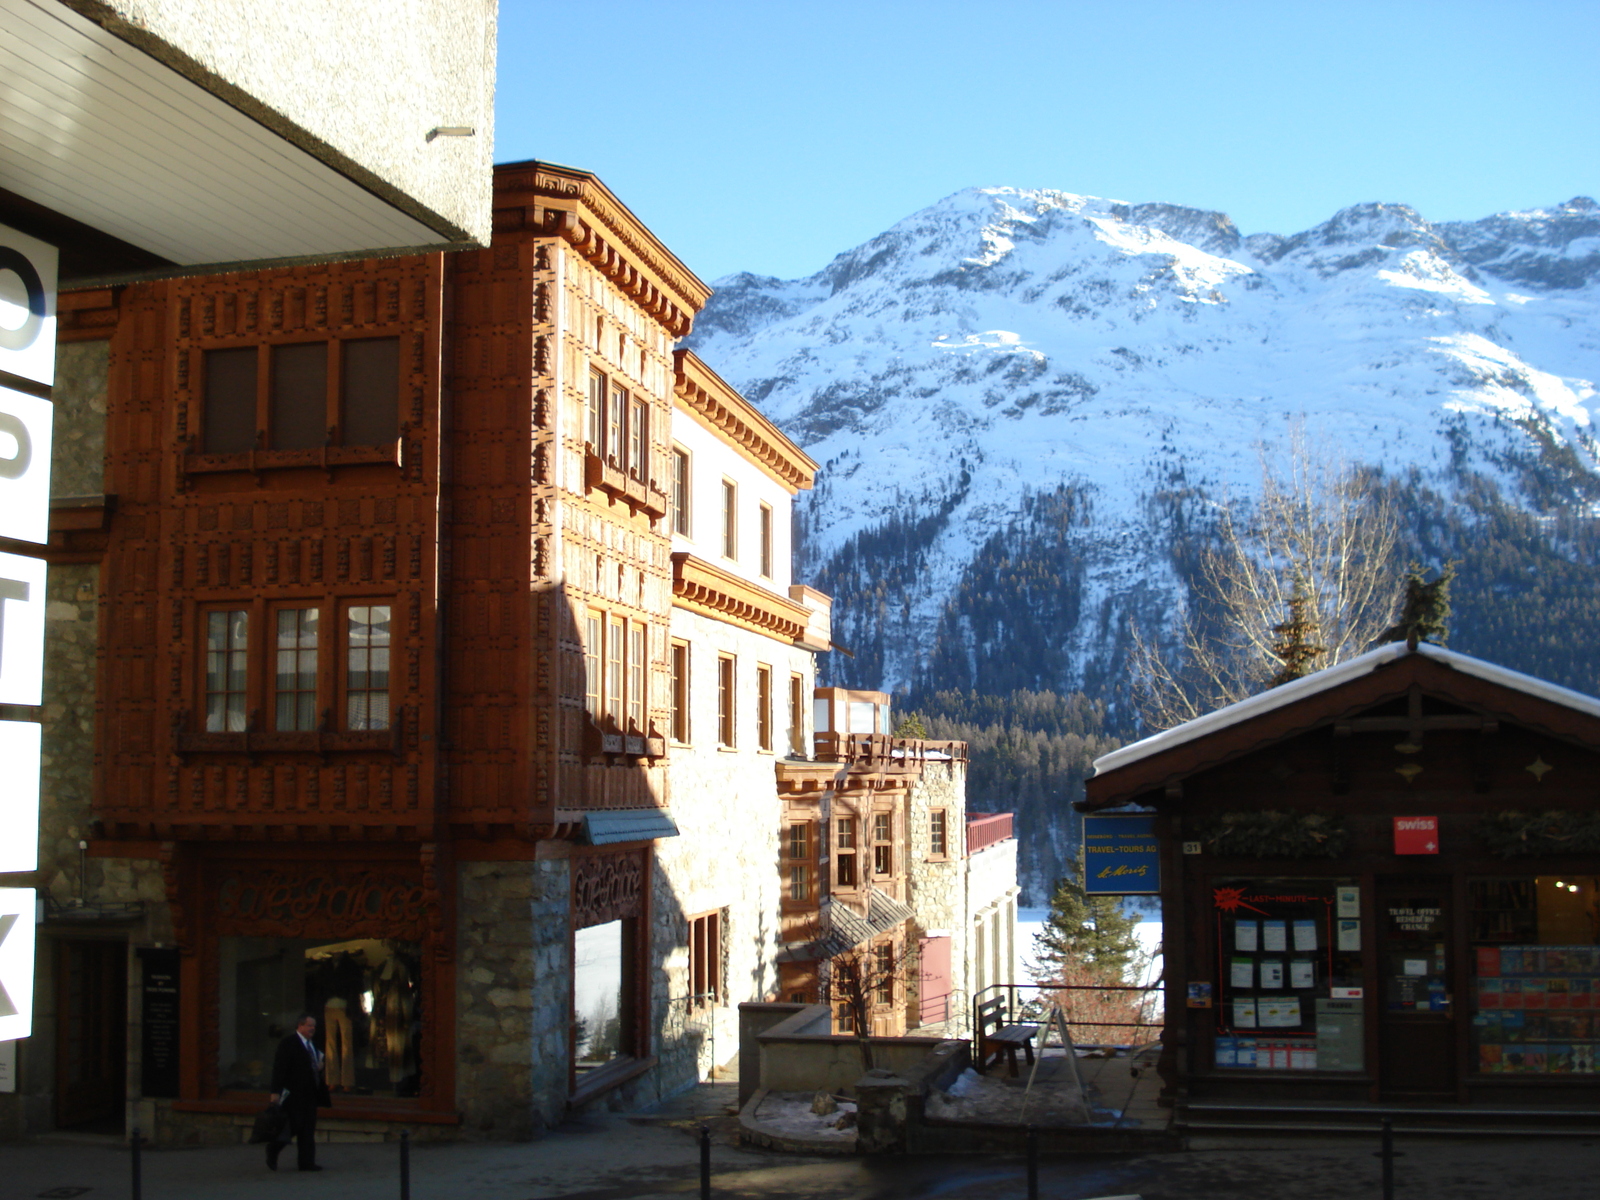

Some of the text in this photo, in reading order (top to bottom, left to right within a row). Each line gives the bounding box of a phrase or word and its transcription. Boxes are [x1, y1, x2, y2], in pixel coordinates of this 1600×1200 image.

[1396, 818, 1435, 831] swiss
[1087, 845, 1157, 854] TRAVEL-TOURS AG
[1186, 844, 1198, 852] 31
[1110, 864, 1149, 877] Moritz
[291, 871, 425, 921] Palace
[1388, 907, 1442, 916] TRAVEL OFFICE
[1400, 923, 1430, 931] CHANGE
